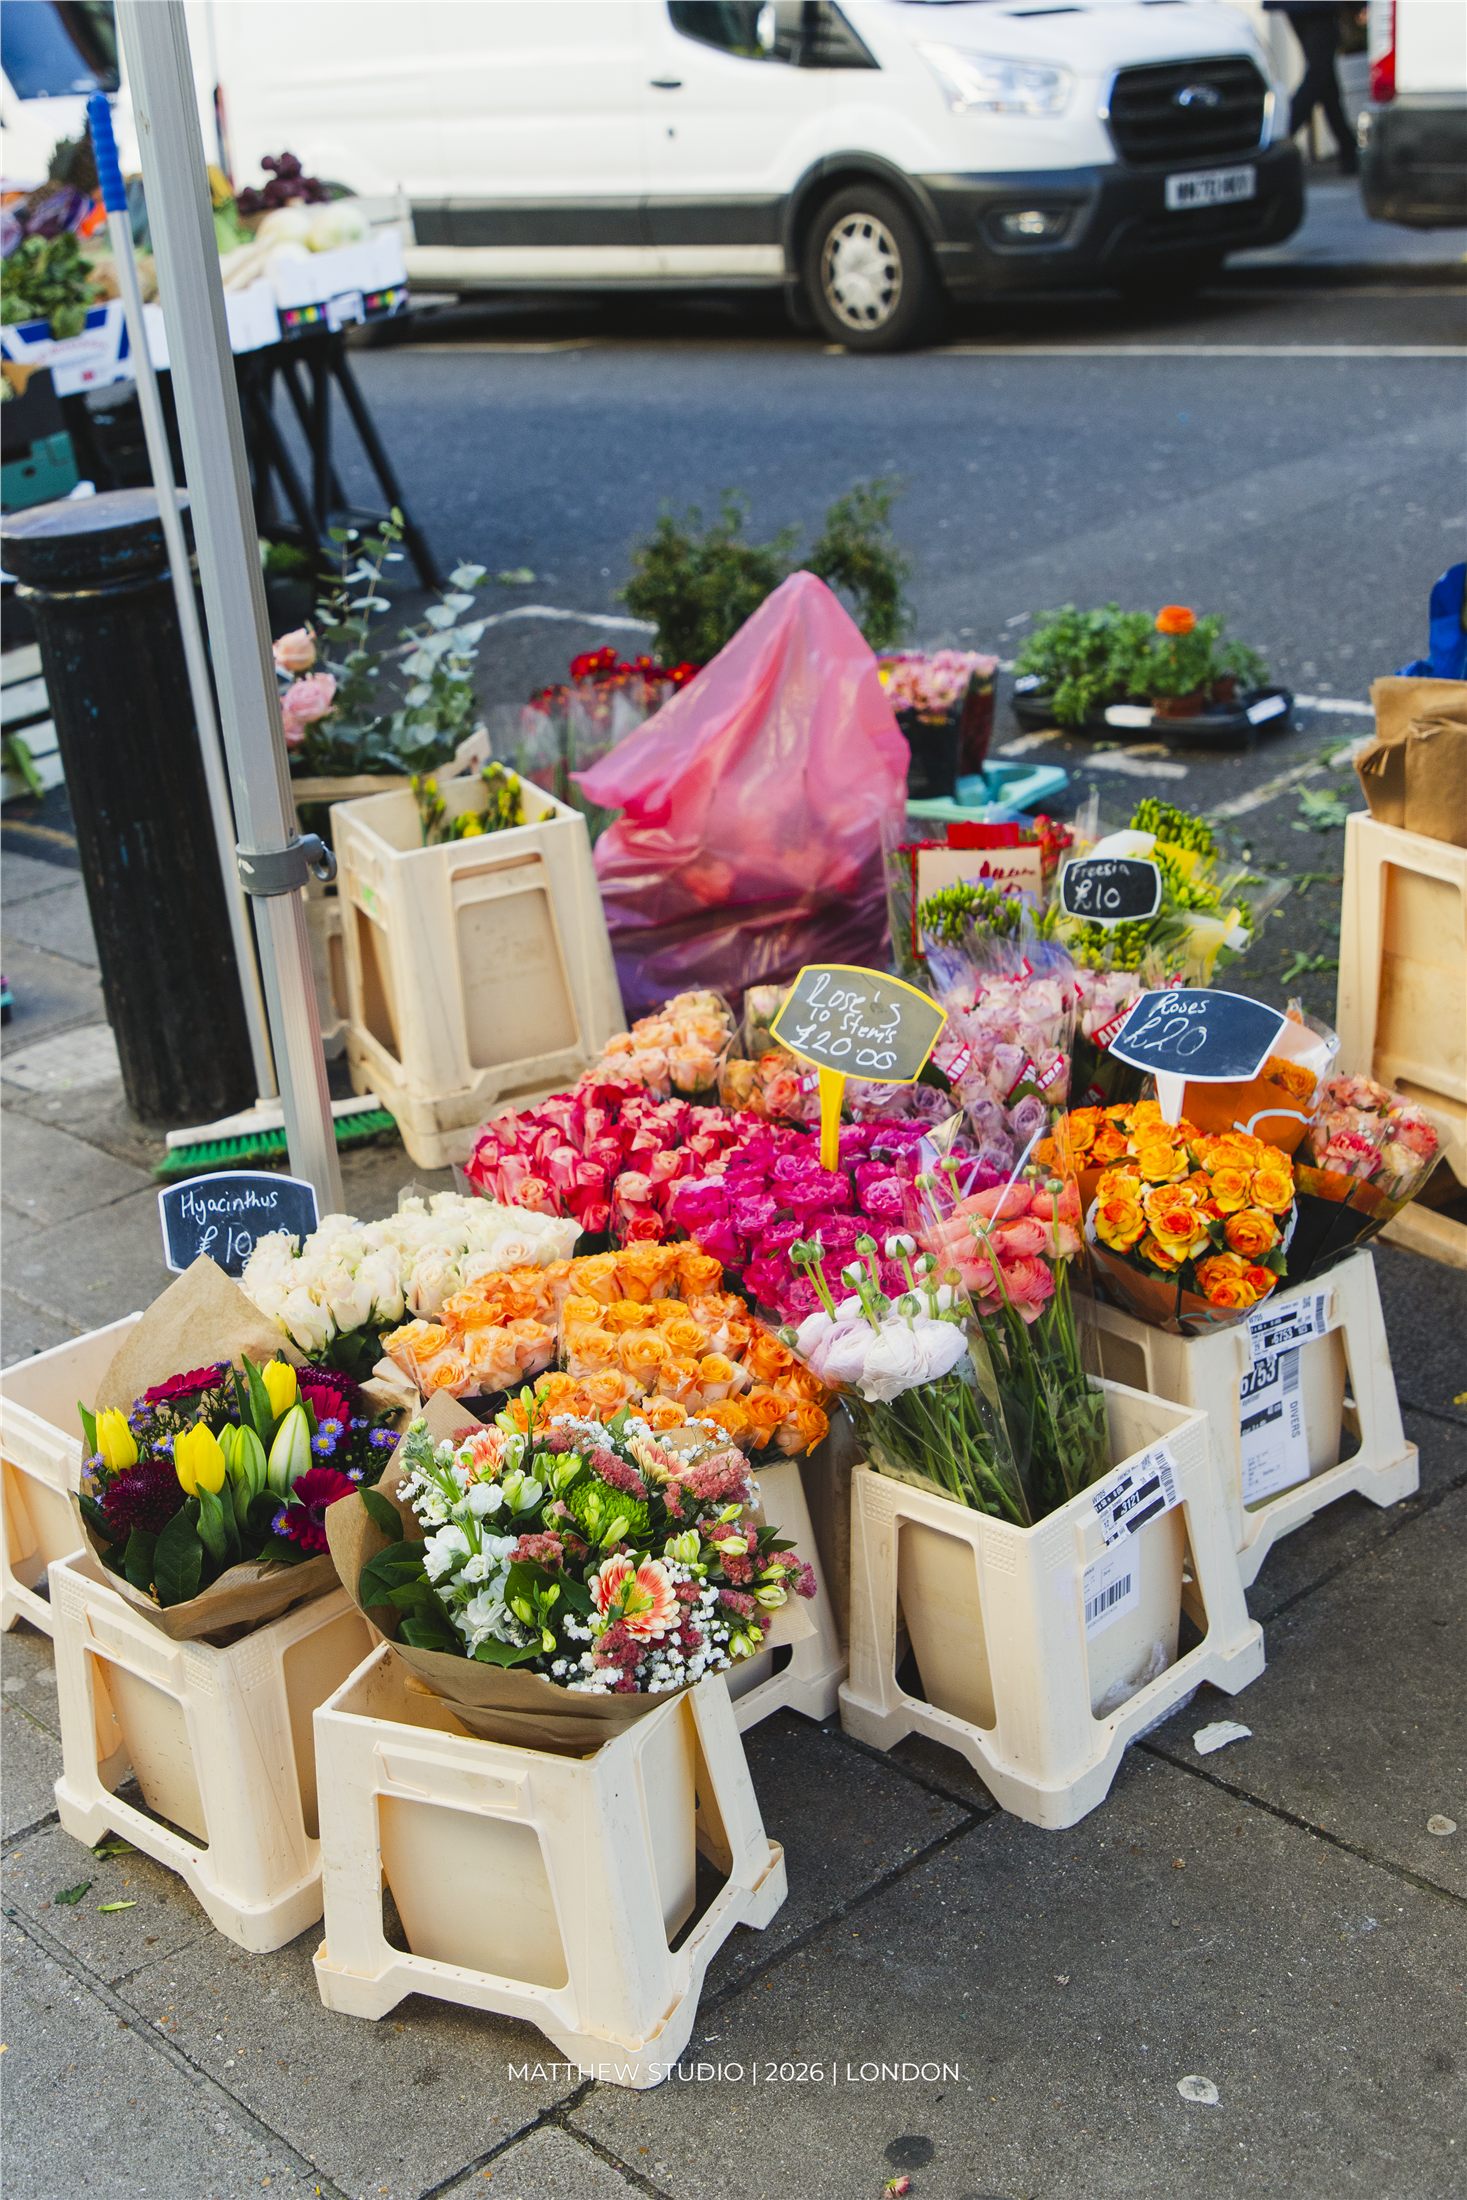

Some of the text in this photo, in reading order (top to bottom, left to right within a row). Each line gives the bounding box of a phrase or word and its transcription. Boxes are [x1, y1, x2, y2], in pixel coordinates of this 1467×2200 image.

[1071, 860, 1130, 882] Freesia
[1073, 879, 1121, 911] £10
[810, 1007, 831, 1022] 10
[1149, 993, 1210, 1018] Roses
[1123, 1017, 1208, 1056] £20
[181, 1190, 278, 1225] Hyacinthus
[1290, 1400, 1301, 1439] DIVERS
